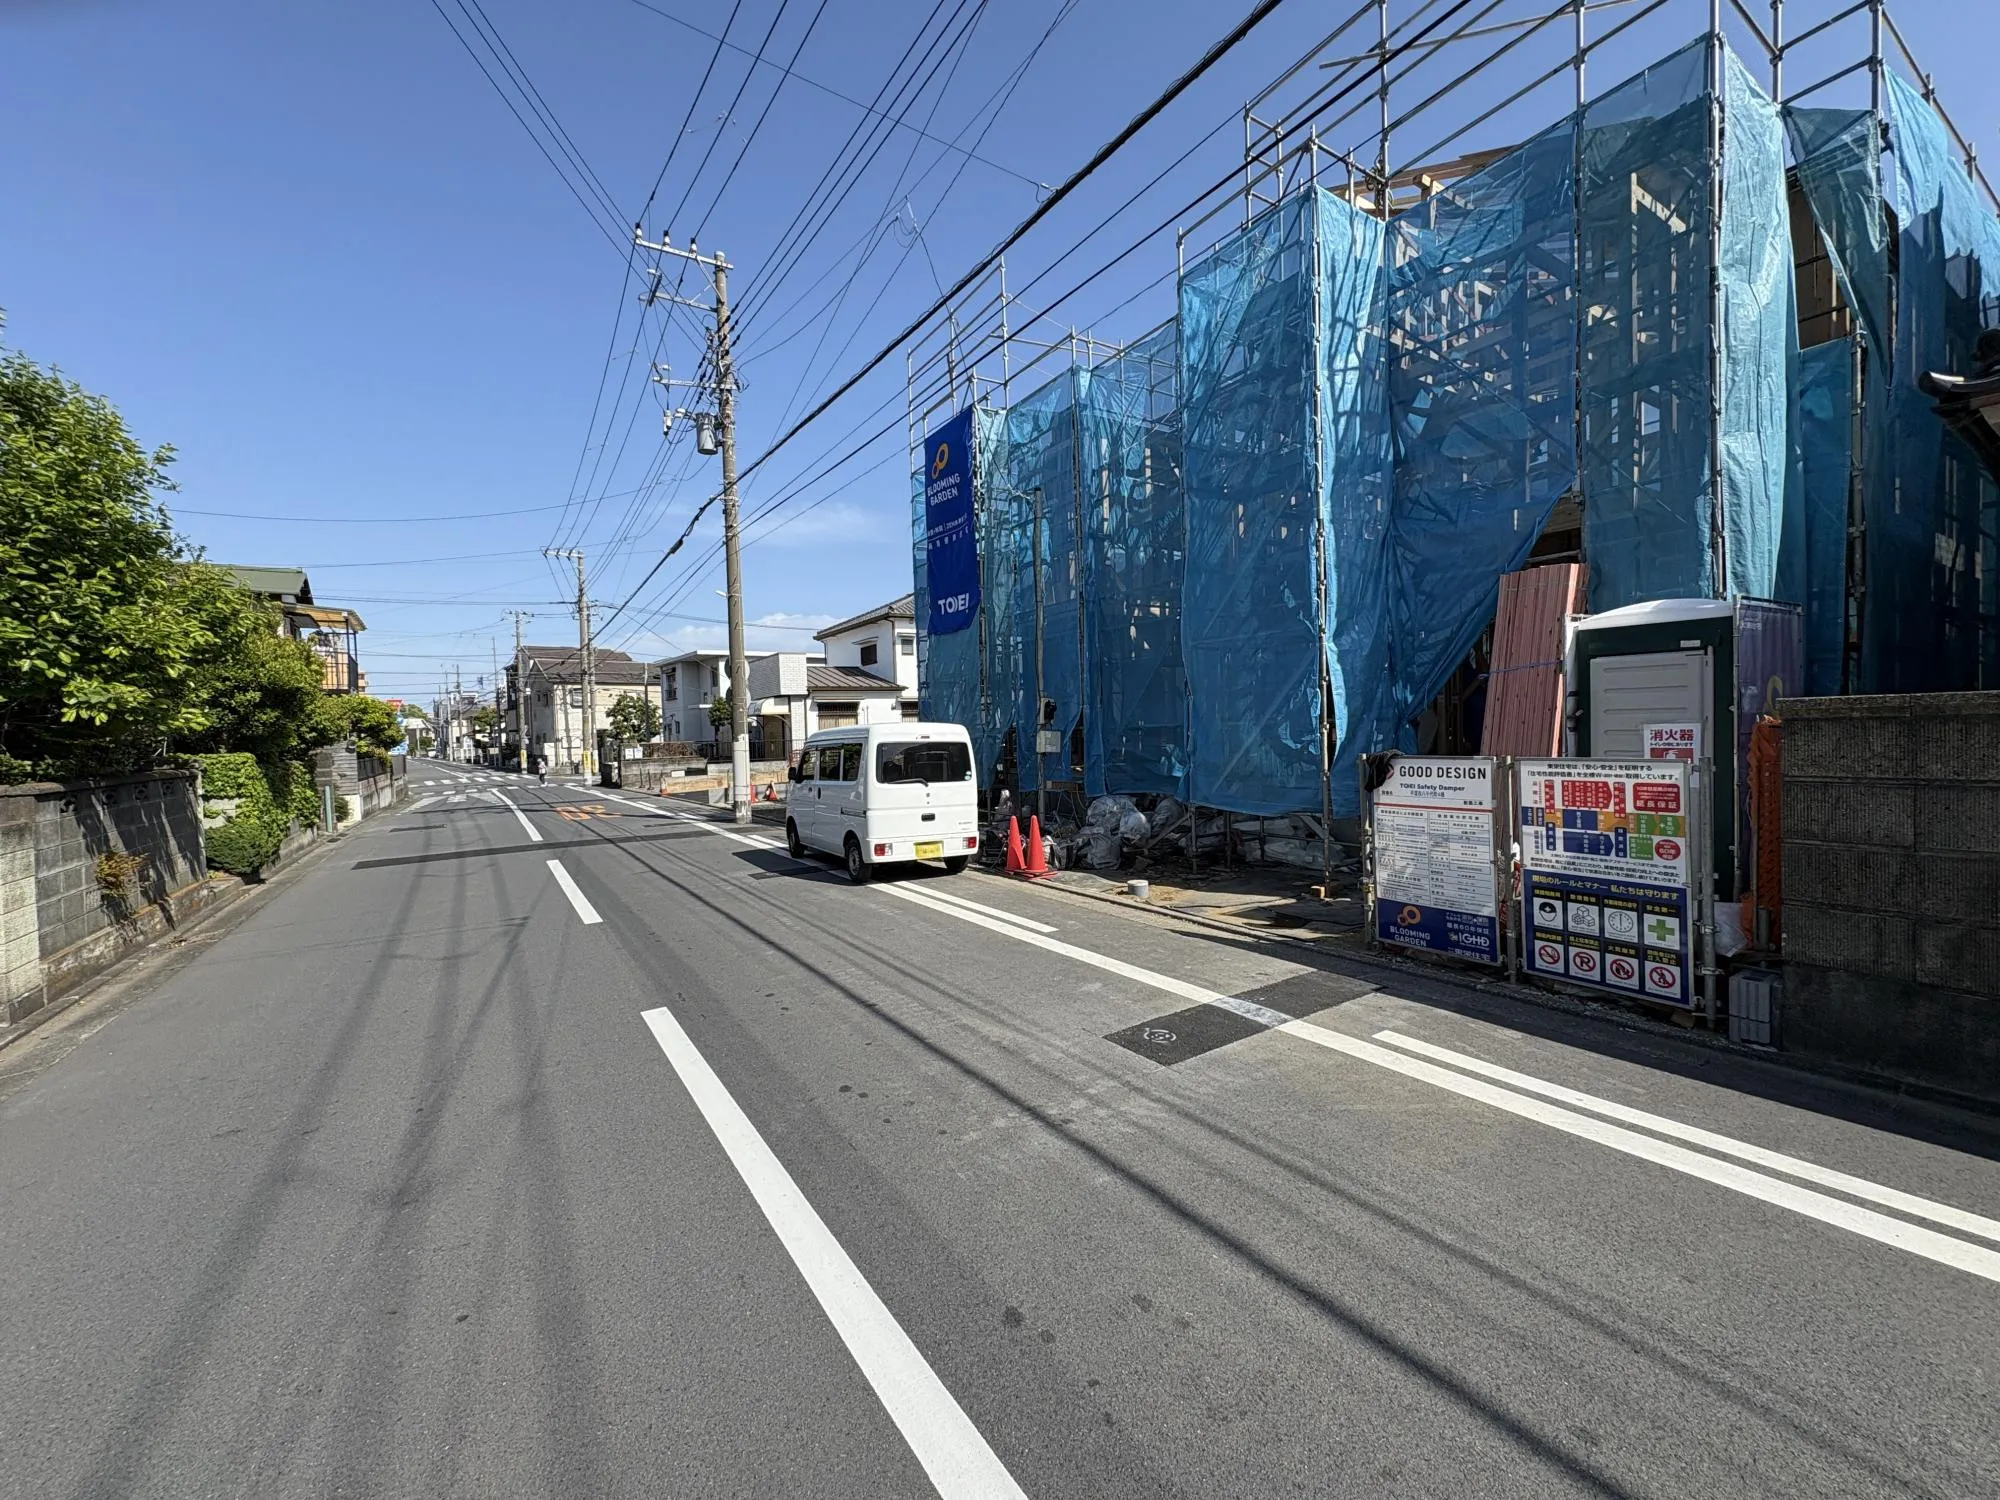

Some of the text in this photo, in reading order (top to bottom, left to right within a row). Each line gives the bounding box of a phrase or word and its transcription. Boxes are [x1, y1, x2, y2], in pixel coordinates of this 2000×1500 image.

[927, 472, 961, 497] BLOOMING
[930, 486, 959, 507] GARDEN
[1649, 728, 1695, 742] 消火器
[1399, 765, 1487, 780] GOOD DESIGN
[1417, 783, 1438, 792] Safety
[1438, 784, 1465, 792] Damper
[1610, 885, 1680, 899] 私たちは守ります
[1389, 925, 1431, 940] BLOOMING
[1394, 934, 1427, 947] GARDEN
